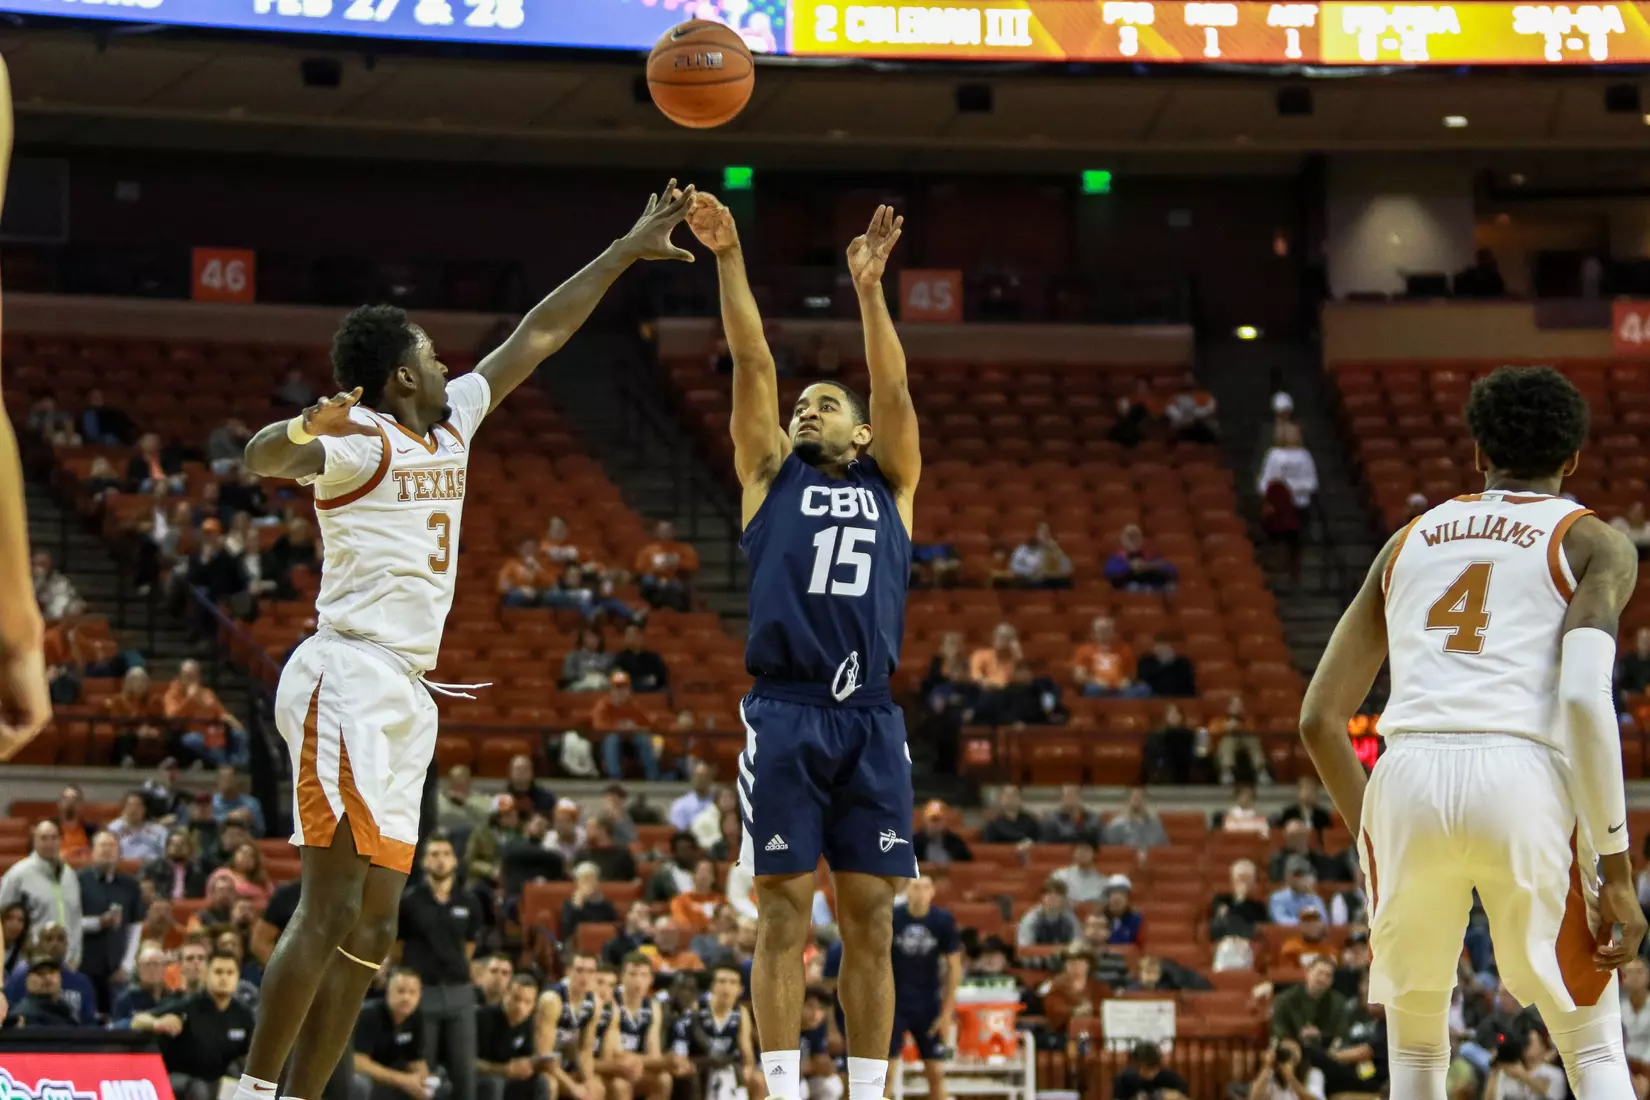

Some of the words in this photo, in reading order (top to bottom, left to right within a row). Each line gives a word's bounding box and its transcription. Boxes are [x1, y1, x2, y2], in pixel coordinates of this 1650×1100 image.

[815, 6, 837, 42] 2
[985, 9, 1033, 46] III
[200, 258, 247, 293] 46
[907, 279, 955, 312] 45
[392, 468, 466, 502] TEXAS
[801, 485, 880, 522] CBU
[427, 510, 451, 574] 3
[1420, 514, 1545, 549] WILLIAMS
[807, 525, 876, 597] 15
[1425, 560, 1494, 655] 4
